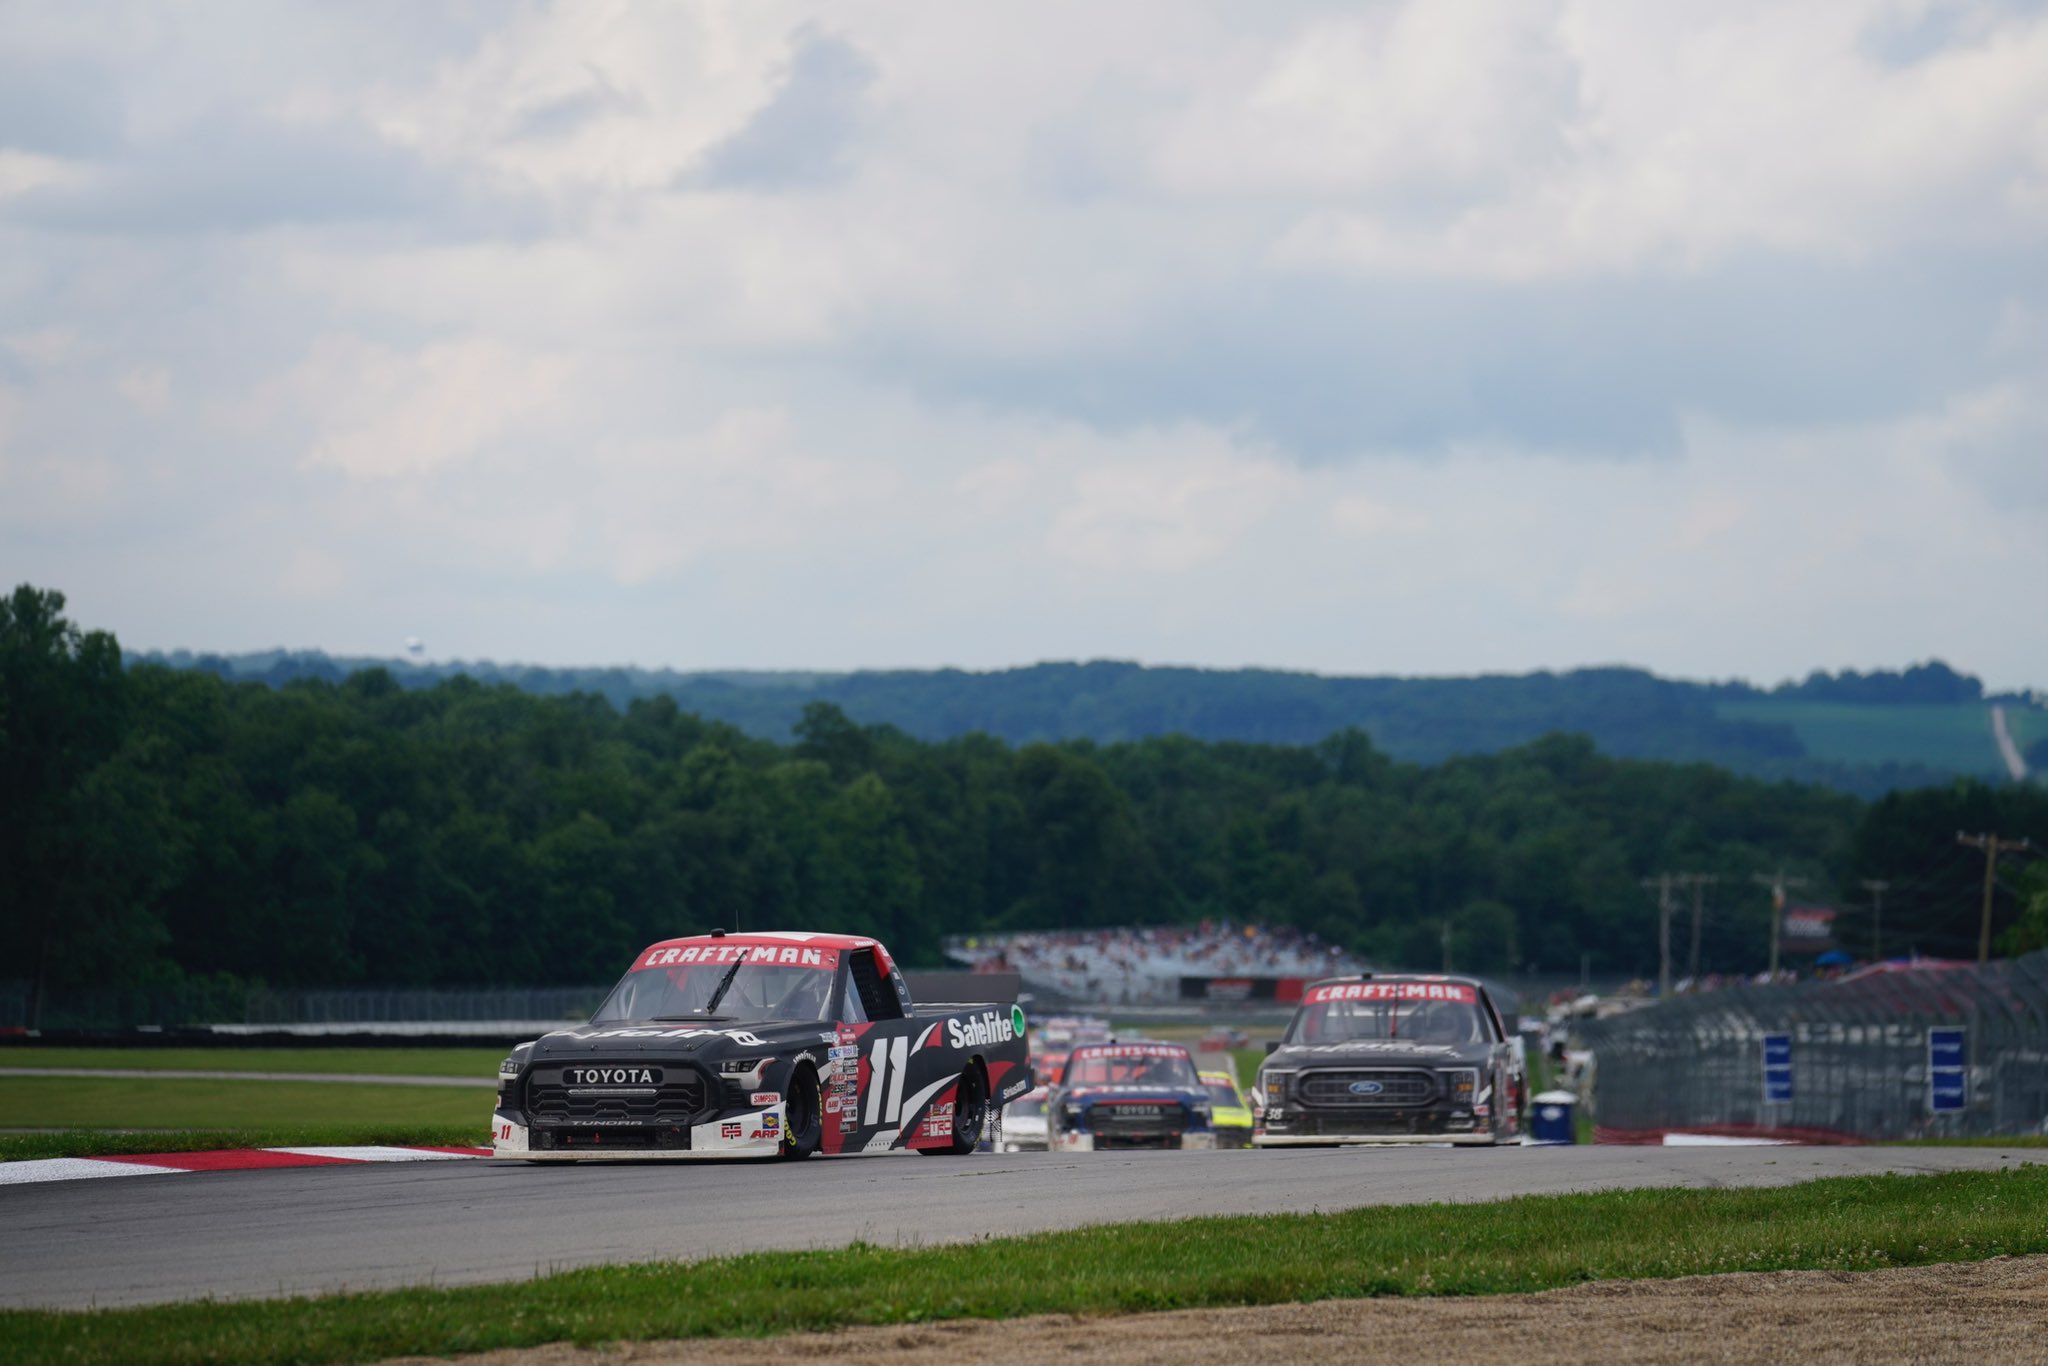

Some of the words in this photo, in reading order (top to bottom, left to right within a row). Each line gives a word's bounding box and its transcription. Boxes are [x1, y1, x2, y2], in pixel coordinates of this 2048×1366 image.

[645, 946, 821, 966] CRAFTSMAN
[1316, 984, 1463, 1000] CRAFTSMAN
[947, 1010, 1012, 1048] Safelite
[574, 1069, 653, 1083] TOYOTA
[864, 1036, 908, 1126] 11
[753, 1094, 778, 1104] SIMPSON
[1115, 1105, 1160, 1115] TOYOTA
[1266, 1107, 1284, 1120] 38
[500, 1124, 511, 1140] 11
[750, 1129, 780, 1138] ARP
